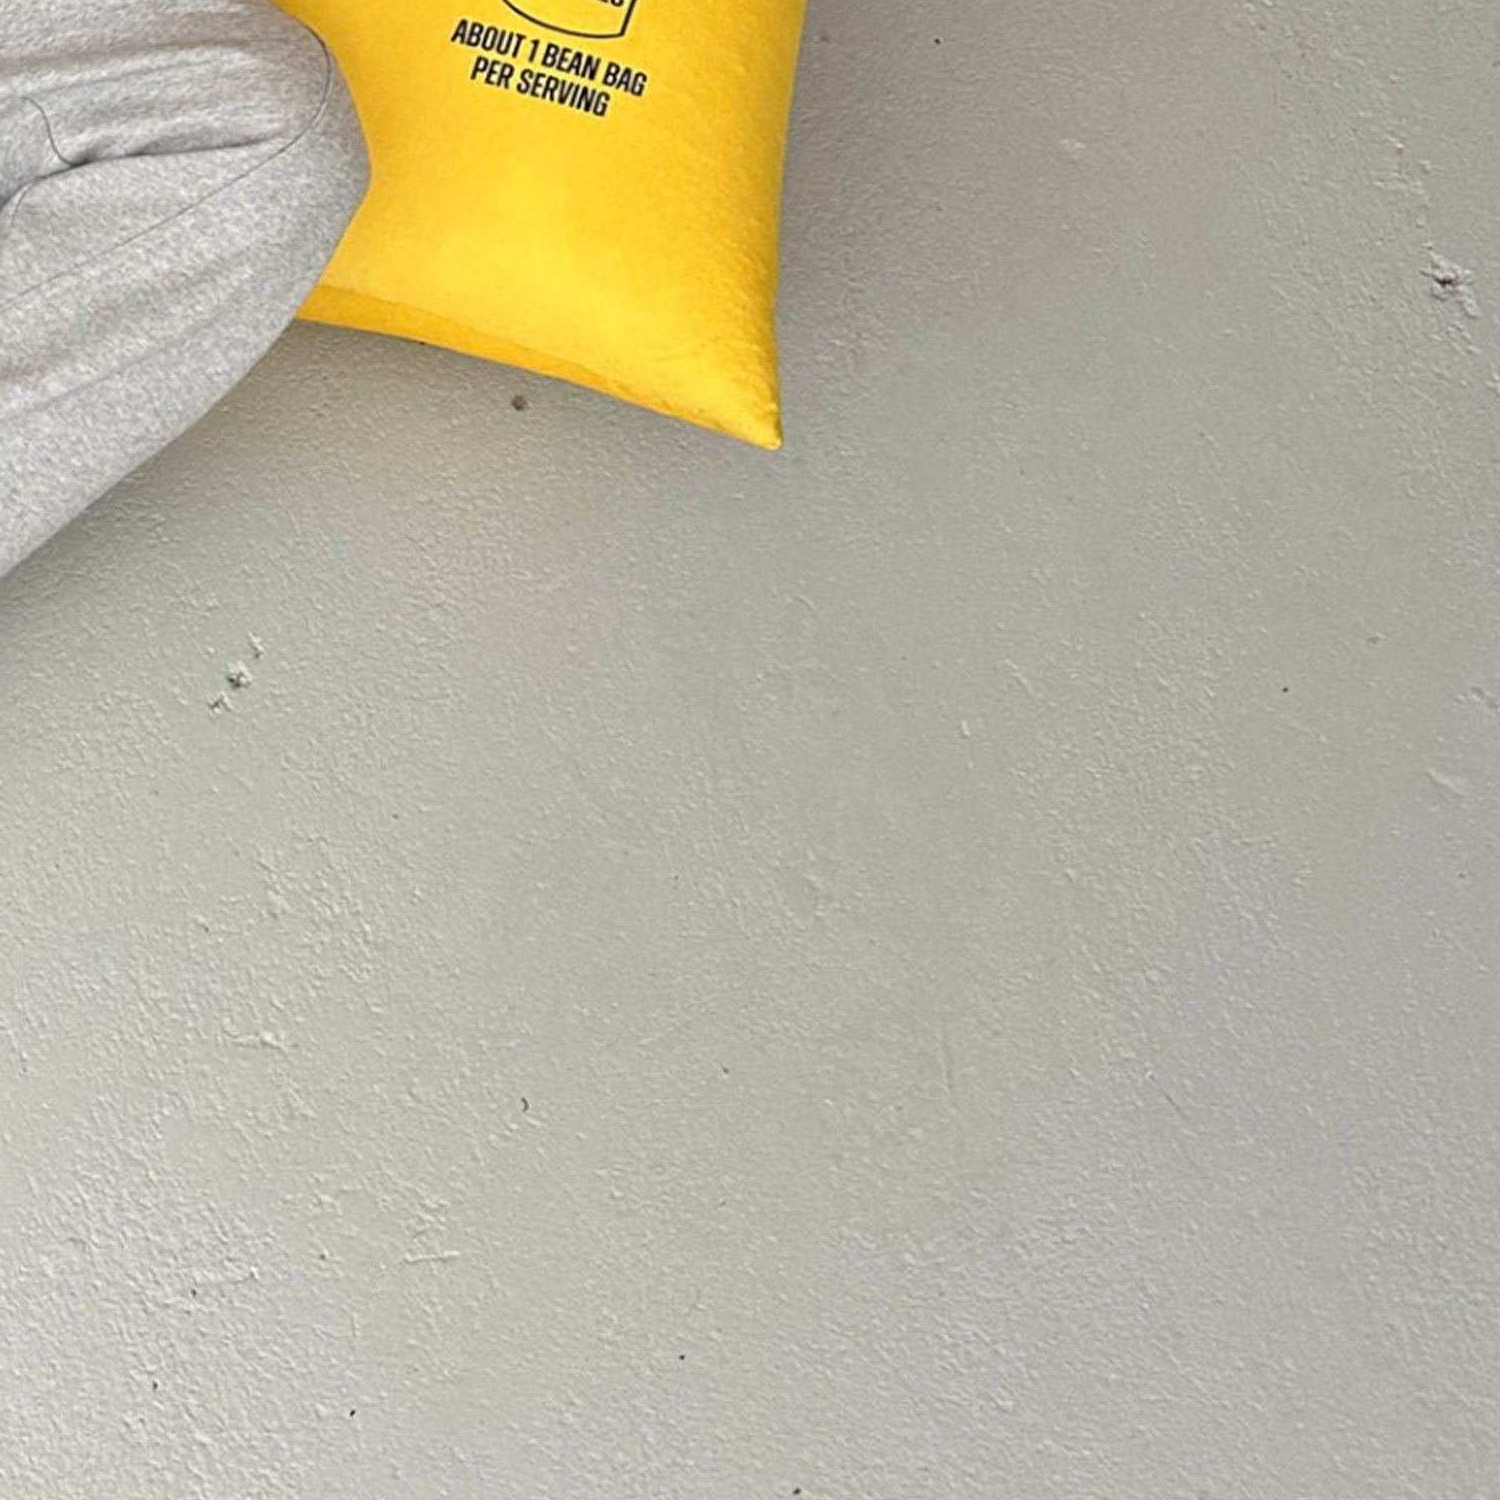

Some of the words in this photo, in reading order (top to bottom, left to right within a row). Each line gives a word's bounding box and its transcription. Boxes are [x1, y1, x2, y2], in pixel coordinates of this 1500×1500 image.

[450, 18, 526, 59] ABOUT
[528, 38, 540, 63] 1
[541, 42, 602, 81] BEAN
[602, 61, 648, 97] BAG
[470, 56, 515, 89] PER
[516, 68, 611, 117] SERVING
